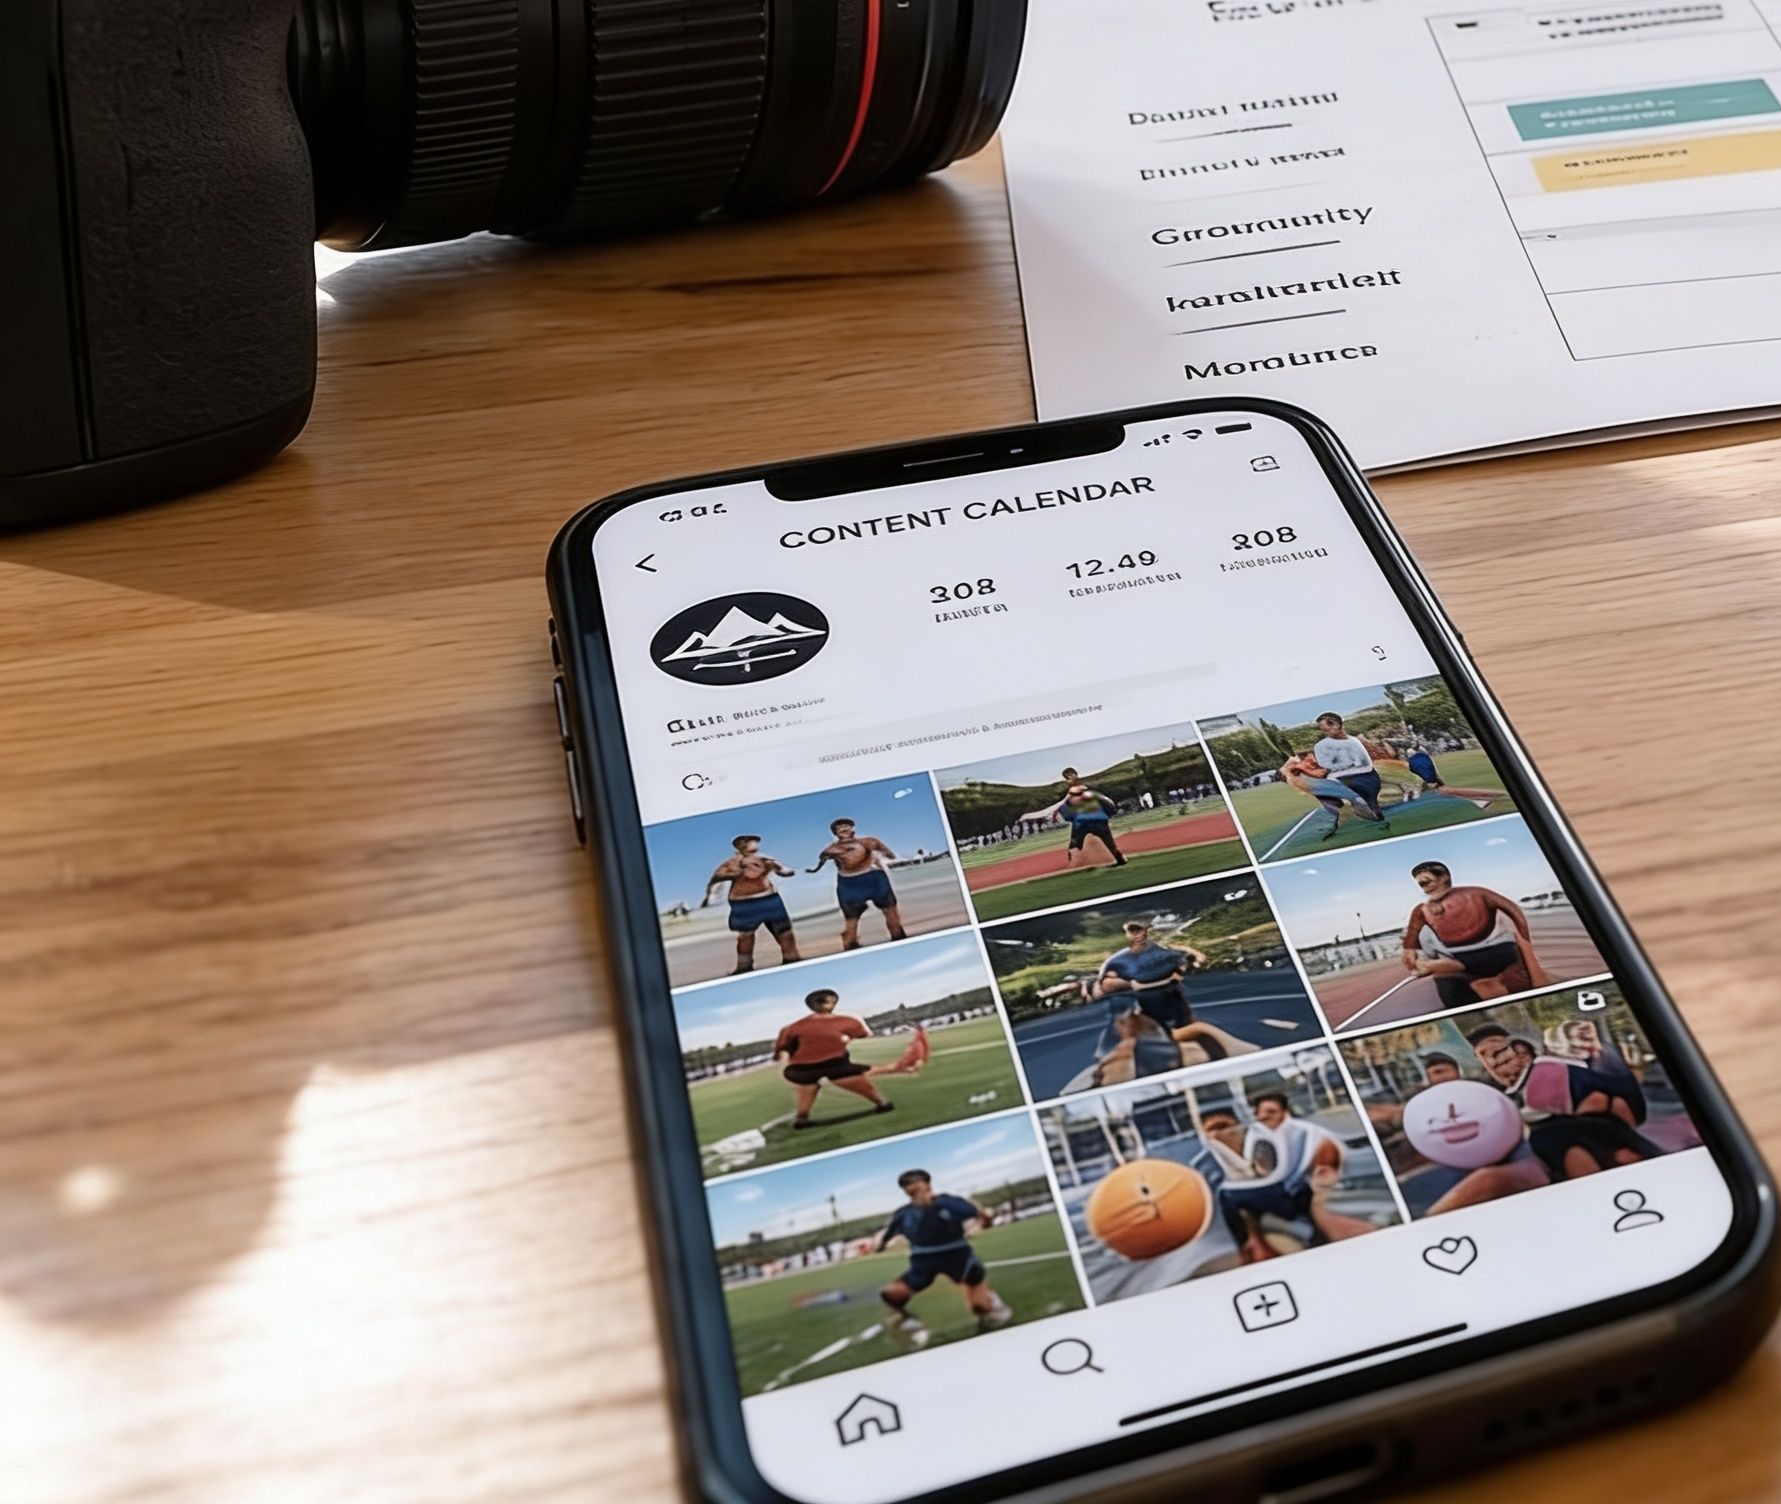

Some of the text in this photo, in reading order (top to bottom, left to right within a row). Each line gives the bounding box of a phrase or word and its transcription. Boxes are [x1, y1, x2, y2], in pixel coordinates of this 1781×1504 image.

[780, 477, 1155, 548] CONTENT CALENDAR
[1066, 551, 1155, 584] 12.49
